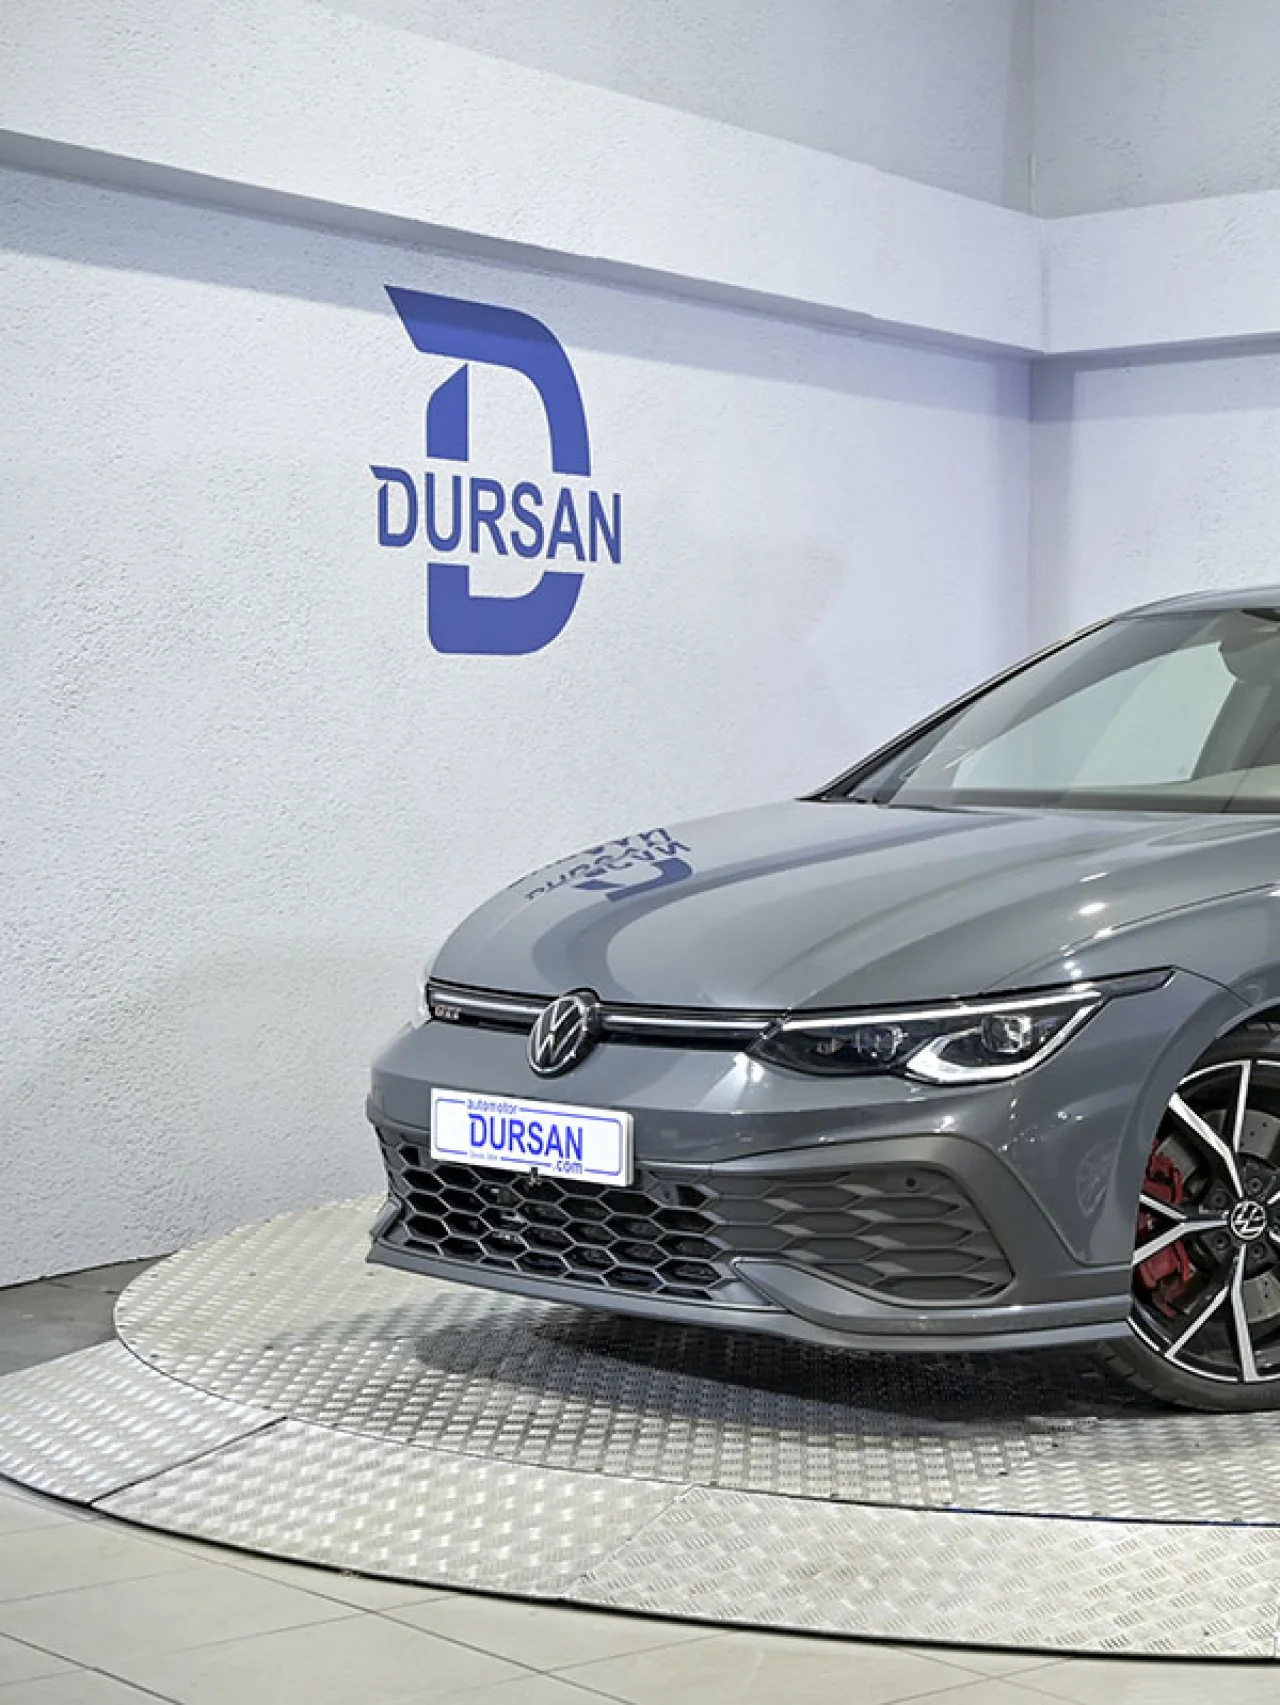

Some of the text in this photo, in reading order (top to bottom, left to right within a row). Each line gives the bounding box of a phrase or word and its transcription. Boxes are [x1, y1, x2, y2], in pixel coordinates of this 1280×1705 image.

[370, 465, 621, 563] DURSAN
[467, 1099, 518, 1114] automotor
[469, 1113, 583, 1161] DURSAN
[552, 1161, 583, 1174] .com
